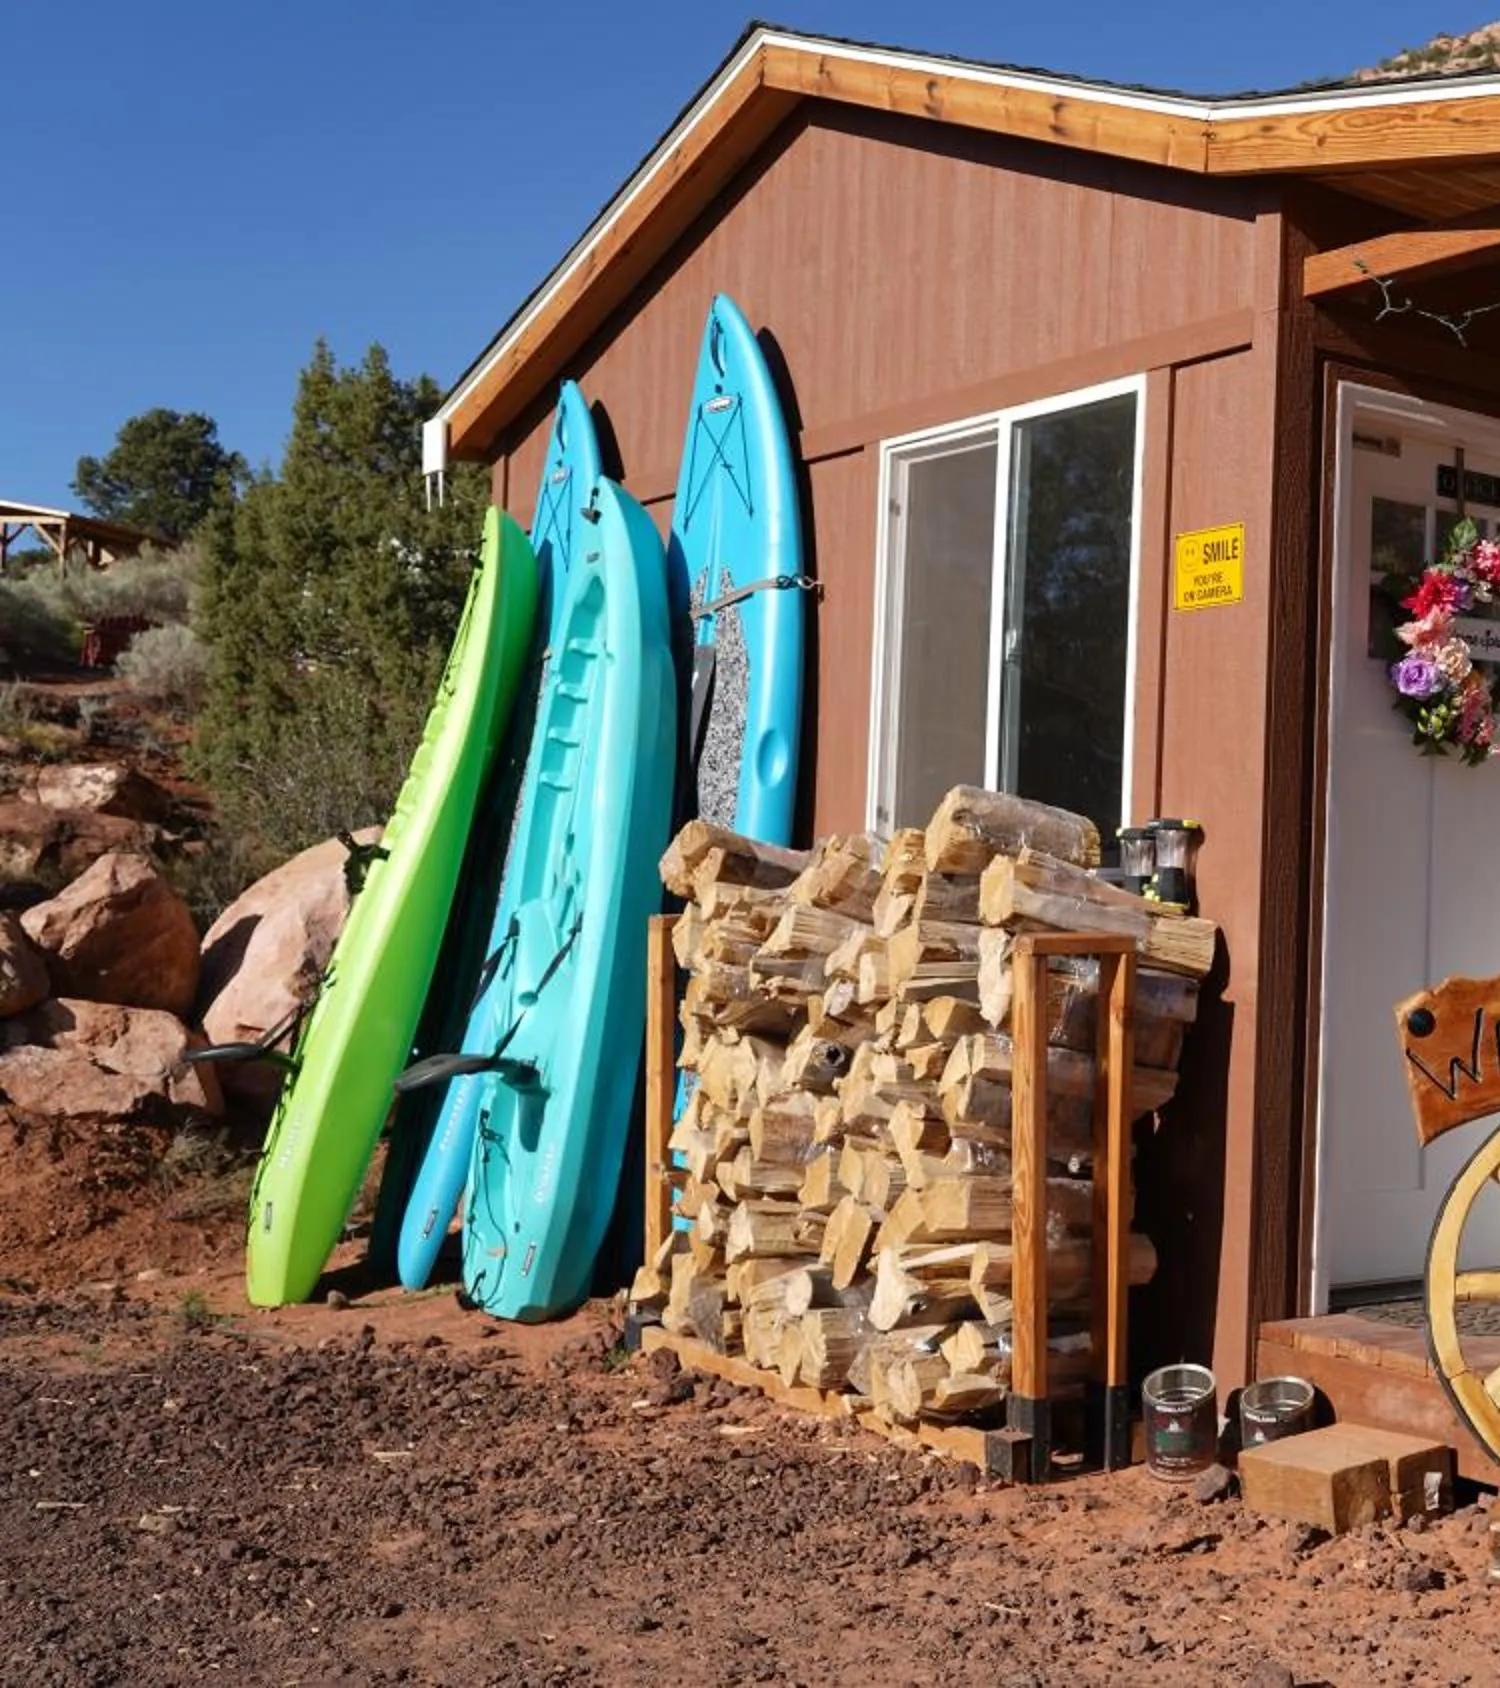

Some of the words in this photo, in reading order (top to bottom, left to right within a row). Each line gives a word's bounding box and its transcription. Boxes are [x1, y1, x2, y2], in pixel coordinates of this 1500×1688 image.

[1203, 538, 1238, 565] SMILE
[1183, 590, 1196, 602] ON
[1198, 585, 1233, 600] CAMERA
